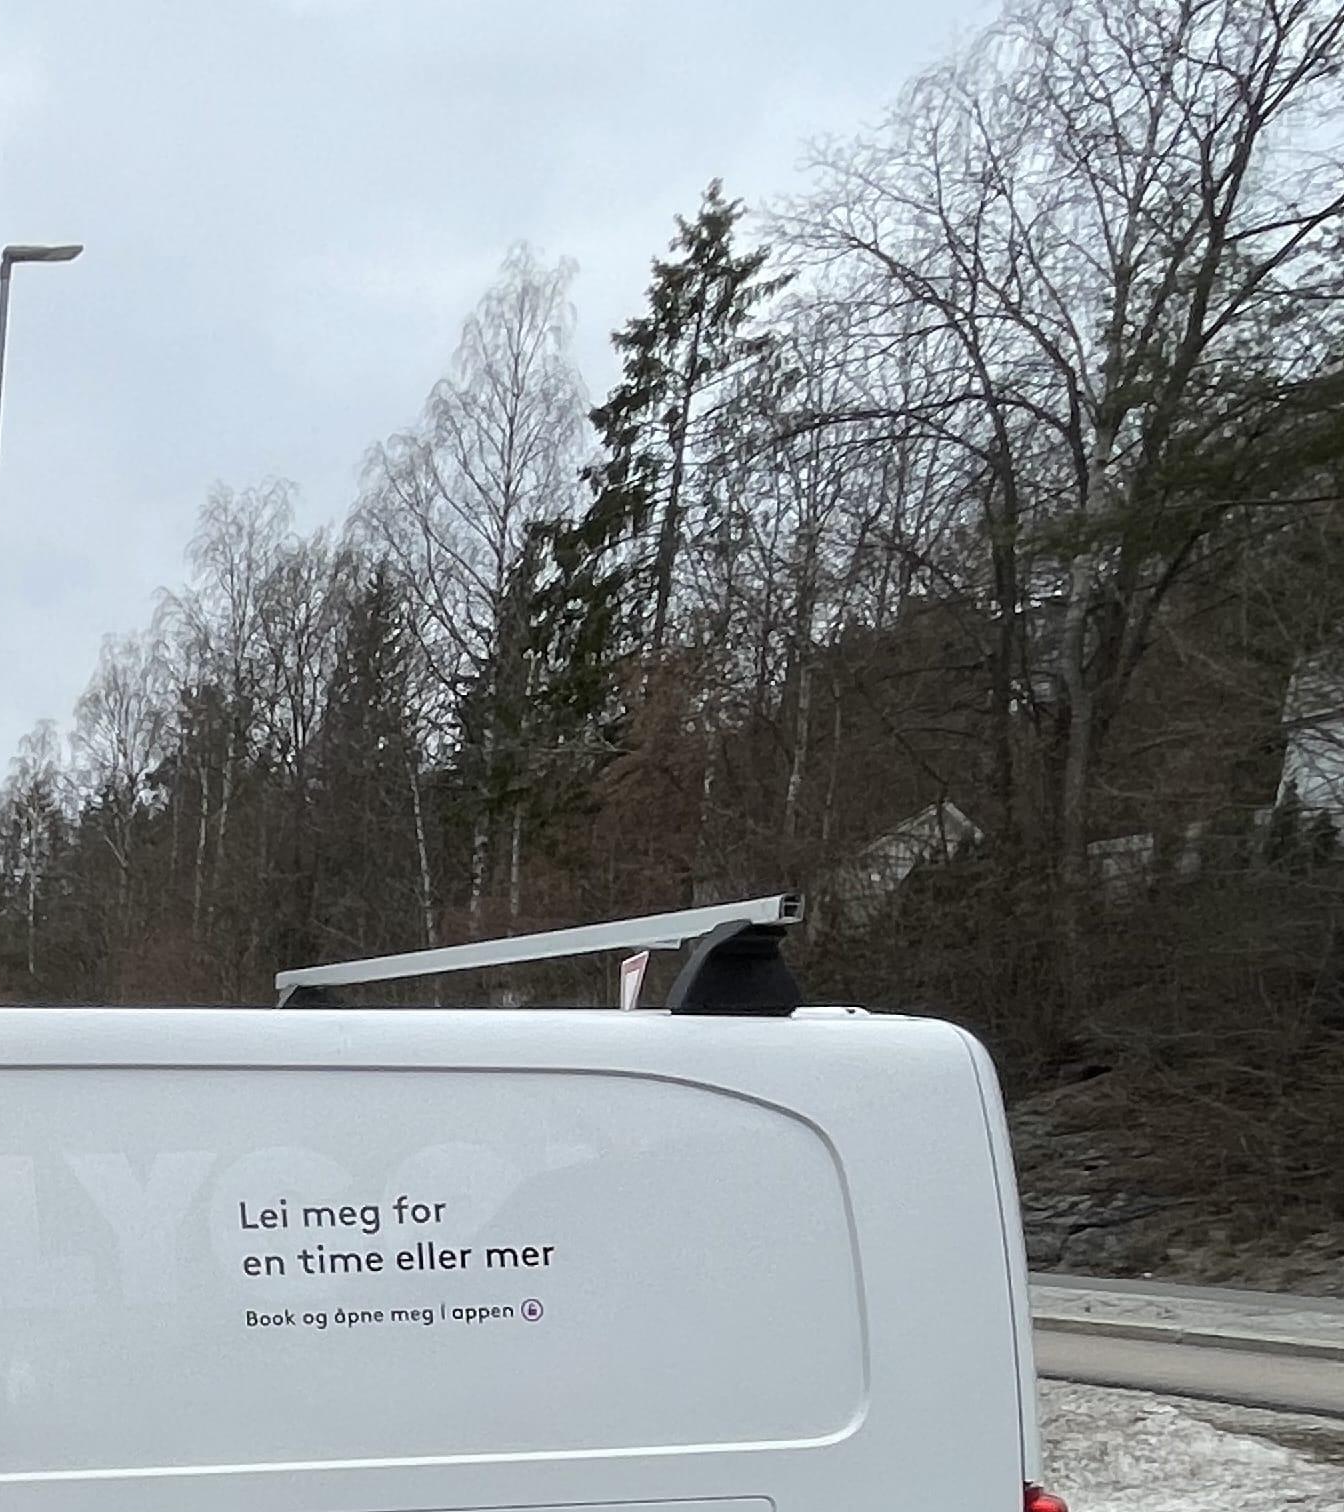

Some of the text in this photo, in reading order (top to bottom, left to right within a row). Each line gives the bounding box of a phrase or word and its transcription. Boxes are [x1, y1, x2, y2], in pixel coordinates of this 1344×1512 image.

[239, 1195, 447, 1234] Lei meg for
[243, 1241, 555, 1276] en time eller mer
[245, 1308, 297, 1327] Book
[302, 1312, 328, 1330] og
[334, 1307, 385, 1328] åpne
[390, 1307, 434, 1326] meg
[451, 1305, 515, 1326] appen
